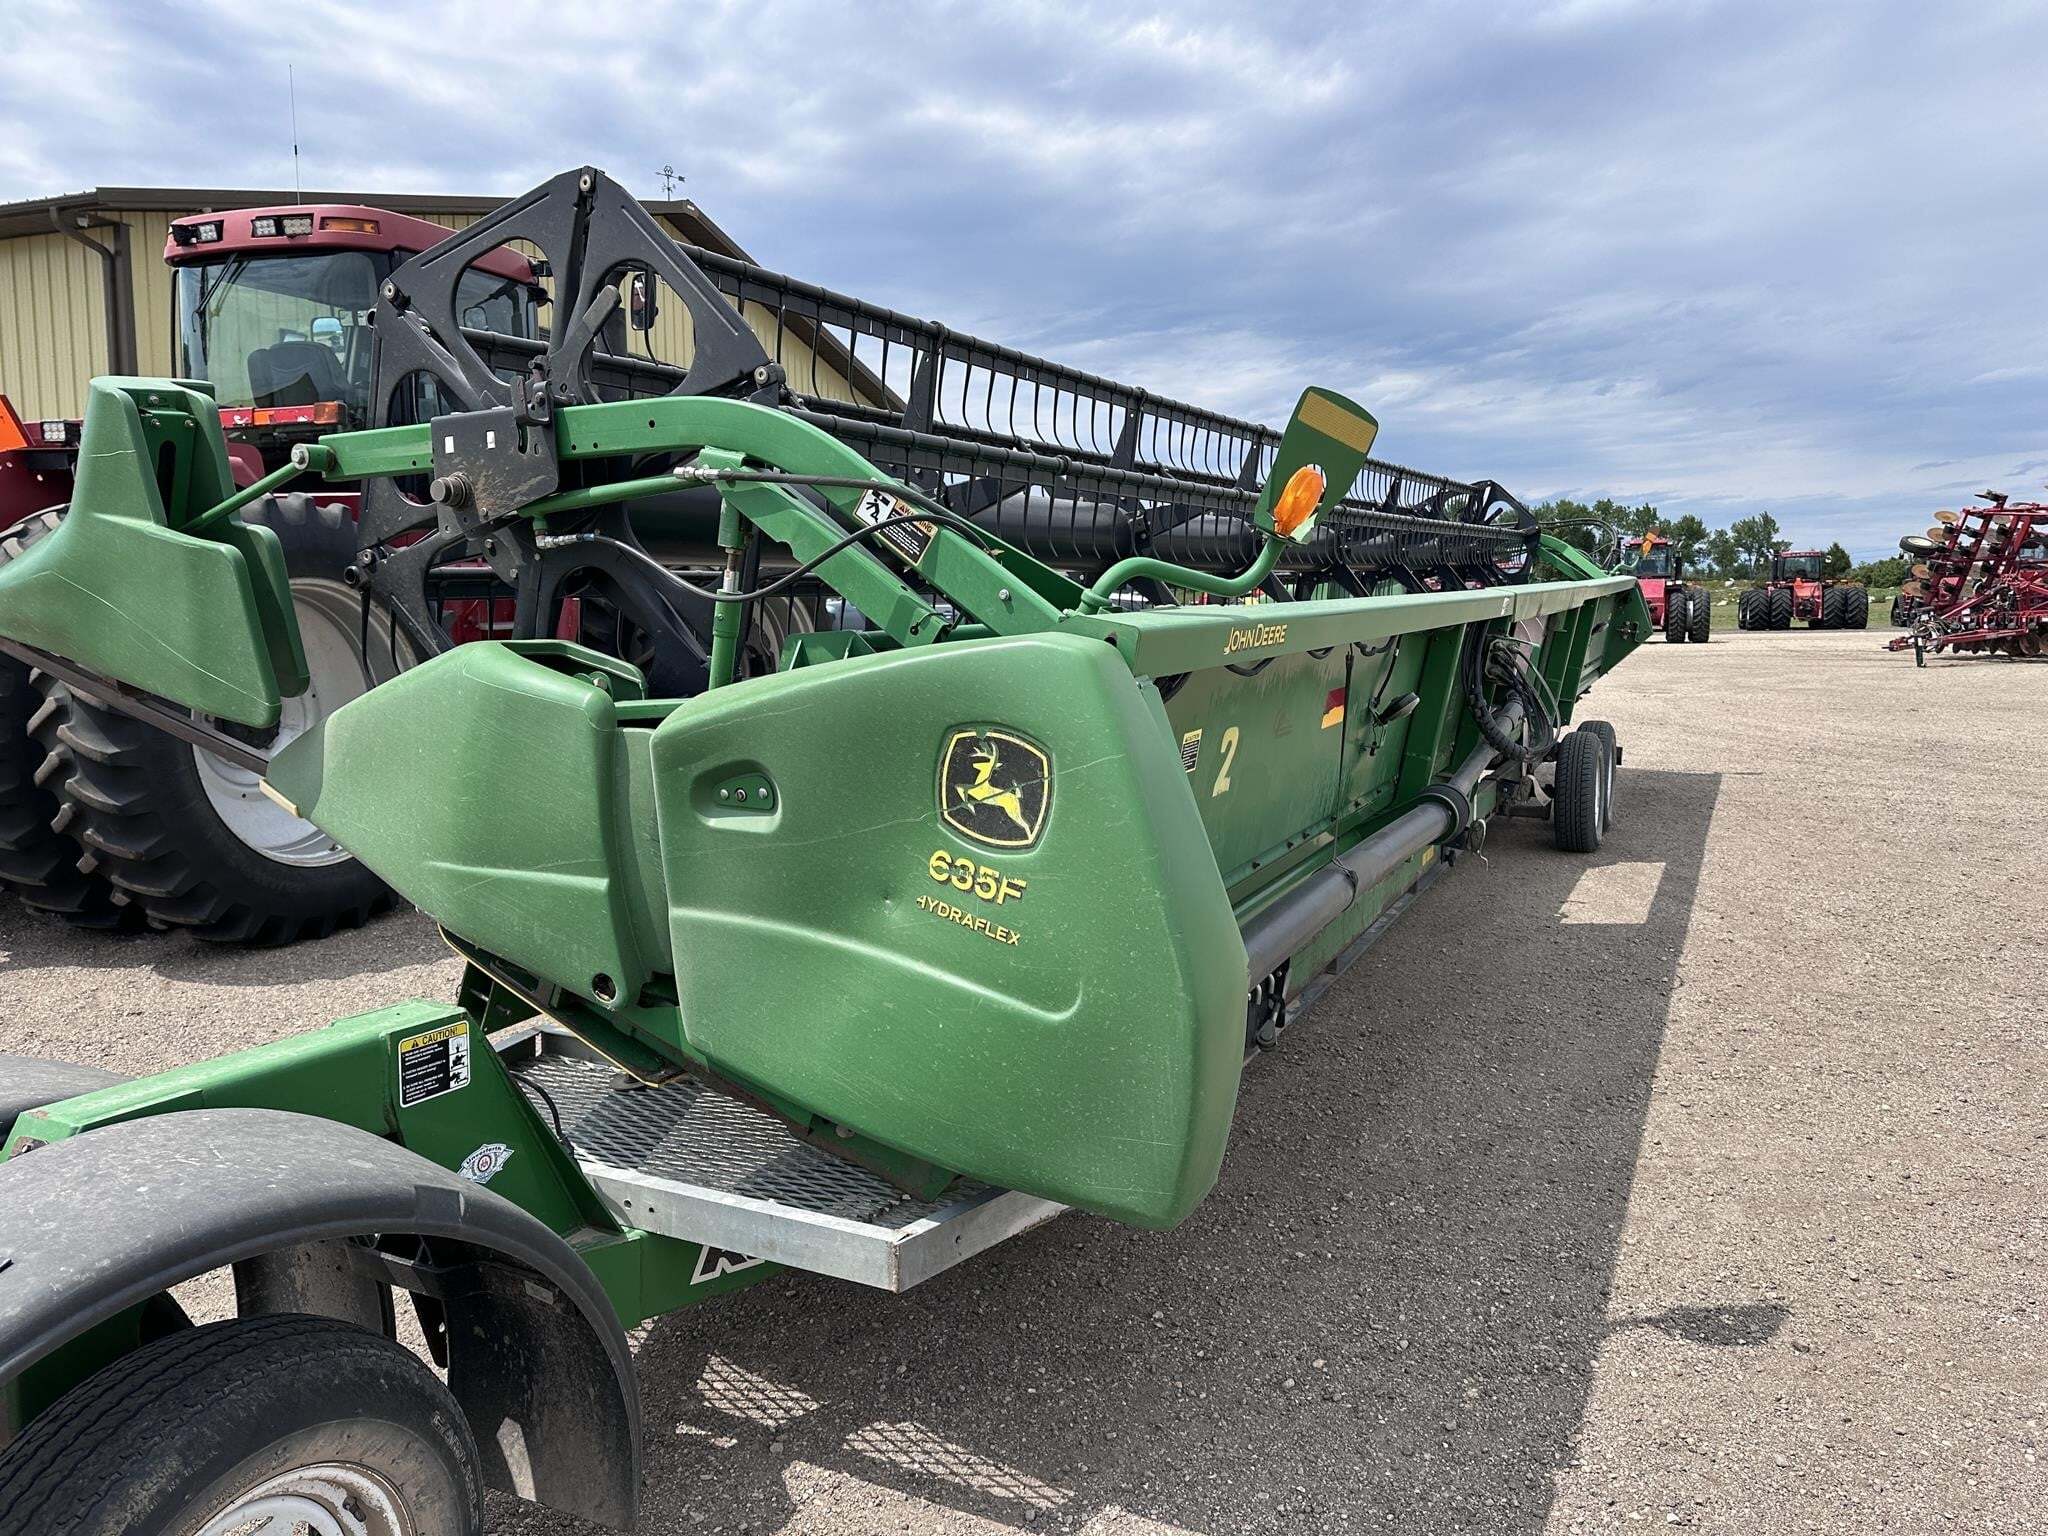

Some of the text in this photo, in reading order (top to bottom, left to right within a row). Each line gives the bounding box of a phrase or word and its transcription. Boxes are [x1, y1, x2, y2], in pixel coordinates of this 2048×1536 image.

[1224, 623, 1288, 655] JOHN DEERE
[1212, 726, 1240, 798] 2
[929, 849, 1027, 905] 635F
[422, 1027, 458, 1045] CAUTION!
